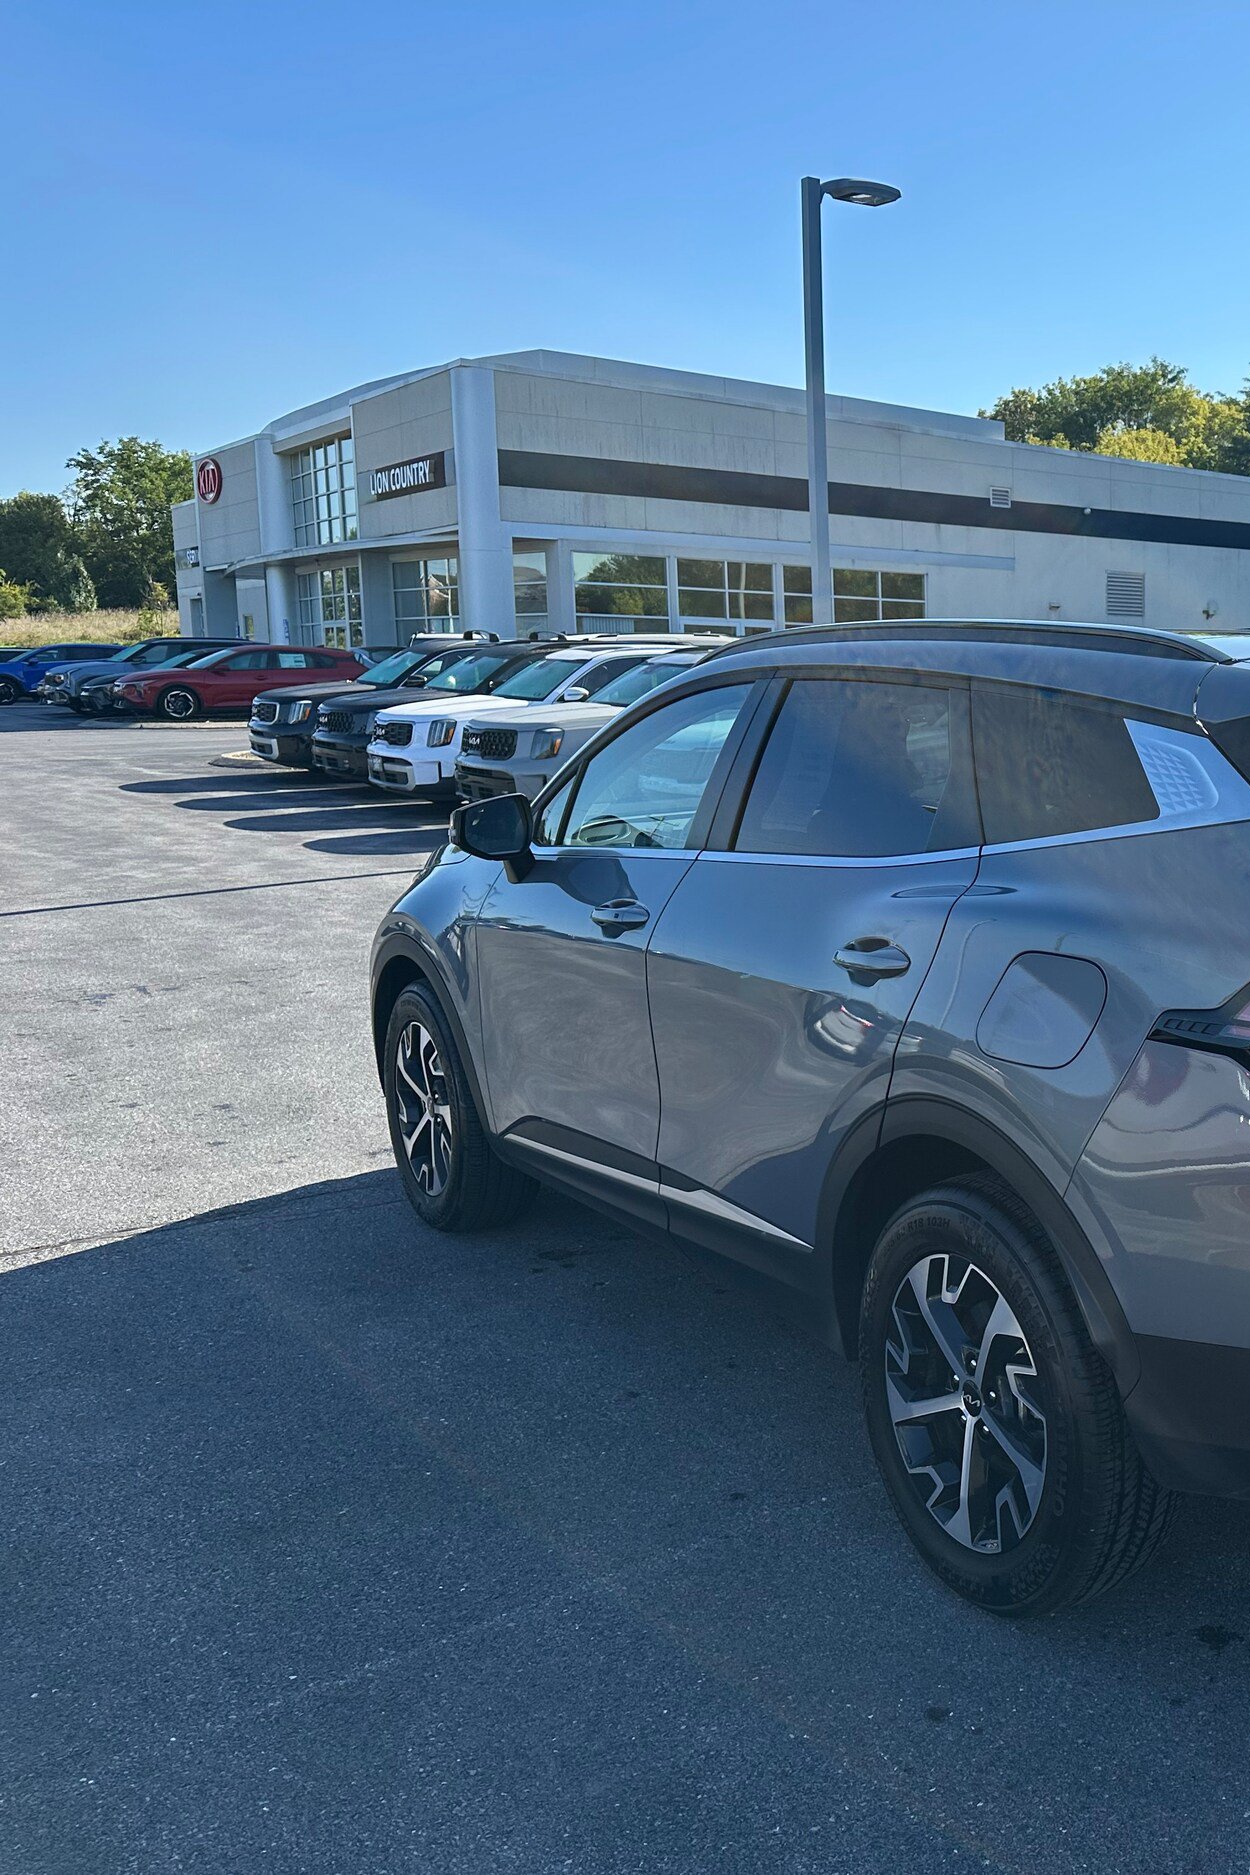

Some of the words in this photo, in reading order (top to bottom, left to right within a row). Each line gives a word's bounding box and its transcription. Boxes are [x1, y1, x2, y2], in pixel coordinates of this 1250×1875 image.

[199, 469, 215, 495] KIA
[370, 470, 389, 495] LION
[390, 460, 430, 491] COUNTRY
